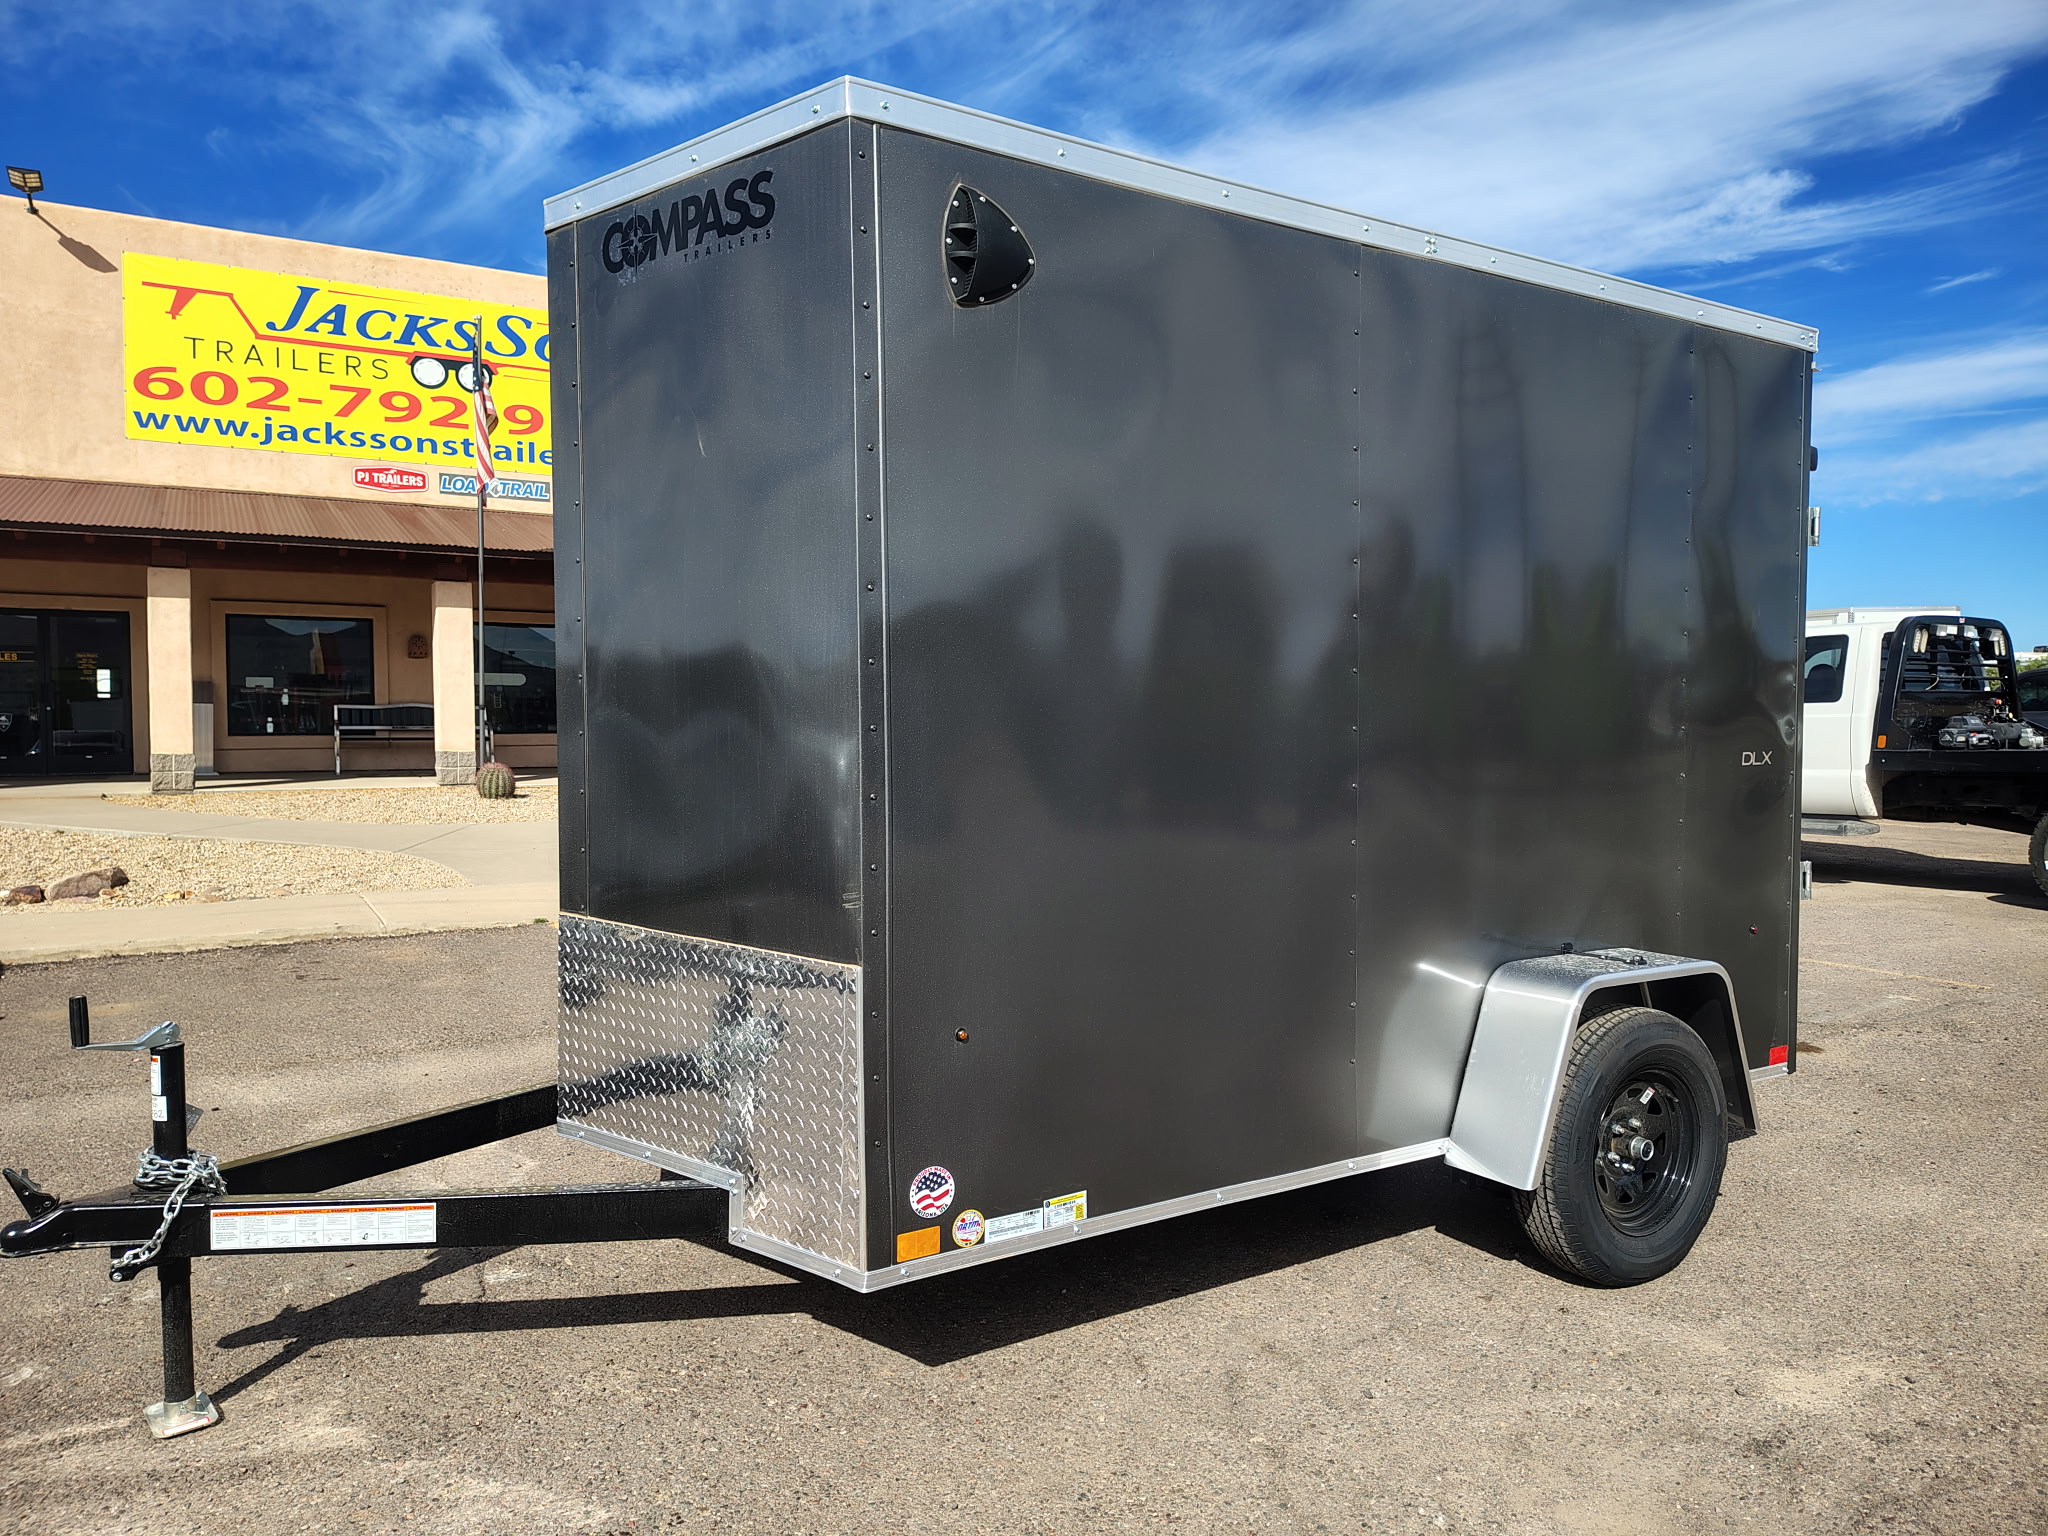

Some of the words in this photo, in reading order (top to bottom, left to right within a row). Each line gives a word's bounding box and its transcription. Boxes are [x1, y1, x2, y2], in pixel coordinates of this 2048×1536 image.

[602, 170, 776, 274] COMPASS
[683, 230, 772, 263] TRAILERS
[183, 336, 390, 380] TRAILERS
[133, 366, 544, 435] 602-7929
[133, 410, 553, 465] www.jackssonstaile
[357, 471, 370, 483] PJ
[372, 472, 424, 487] TRAILERS
[500, 481, 549, 498] TRAIL
[1741, 751, 1773, 766] DLX
